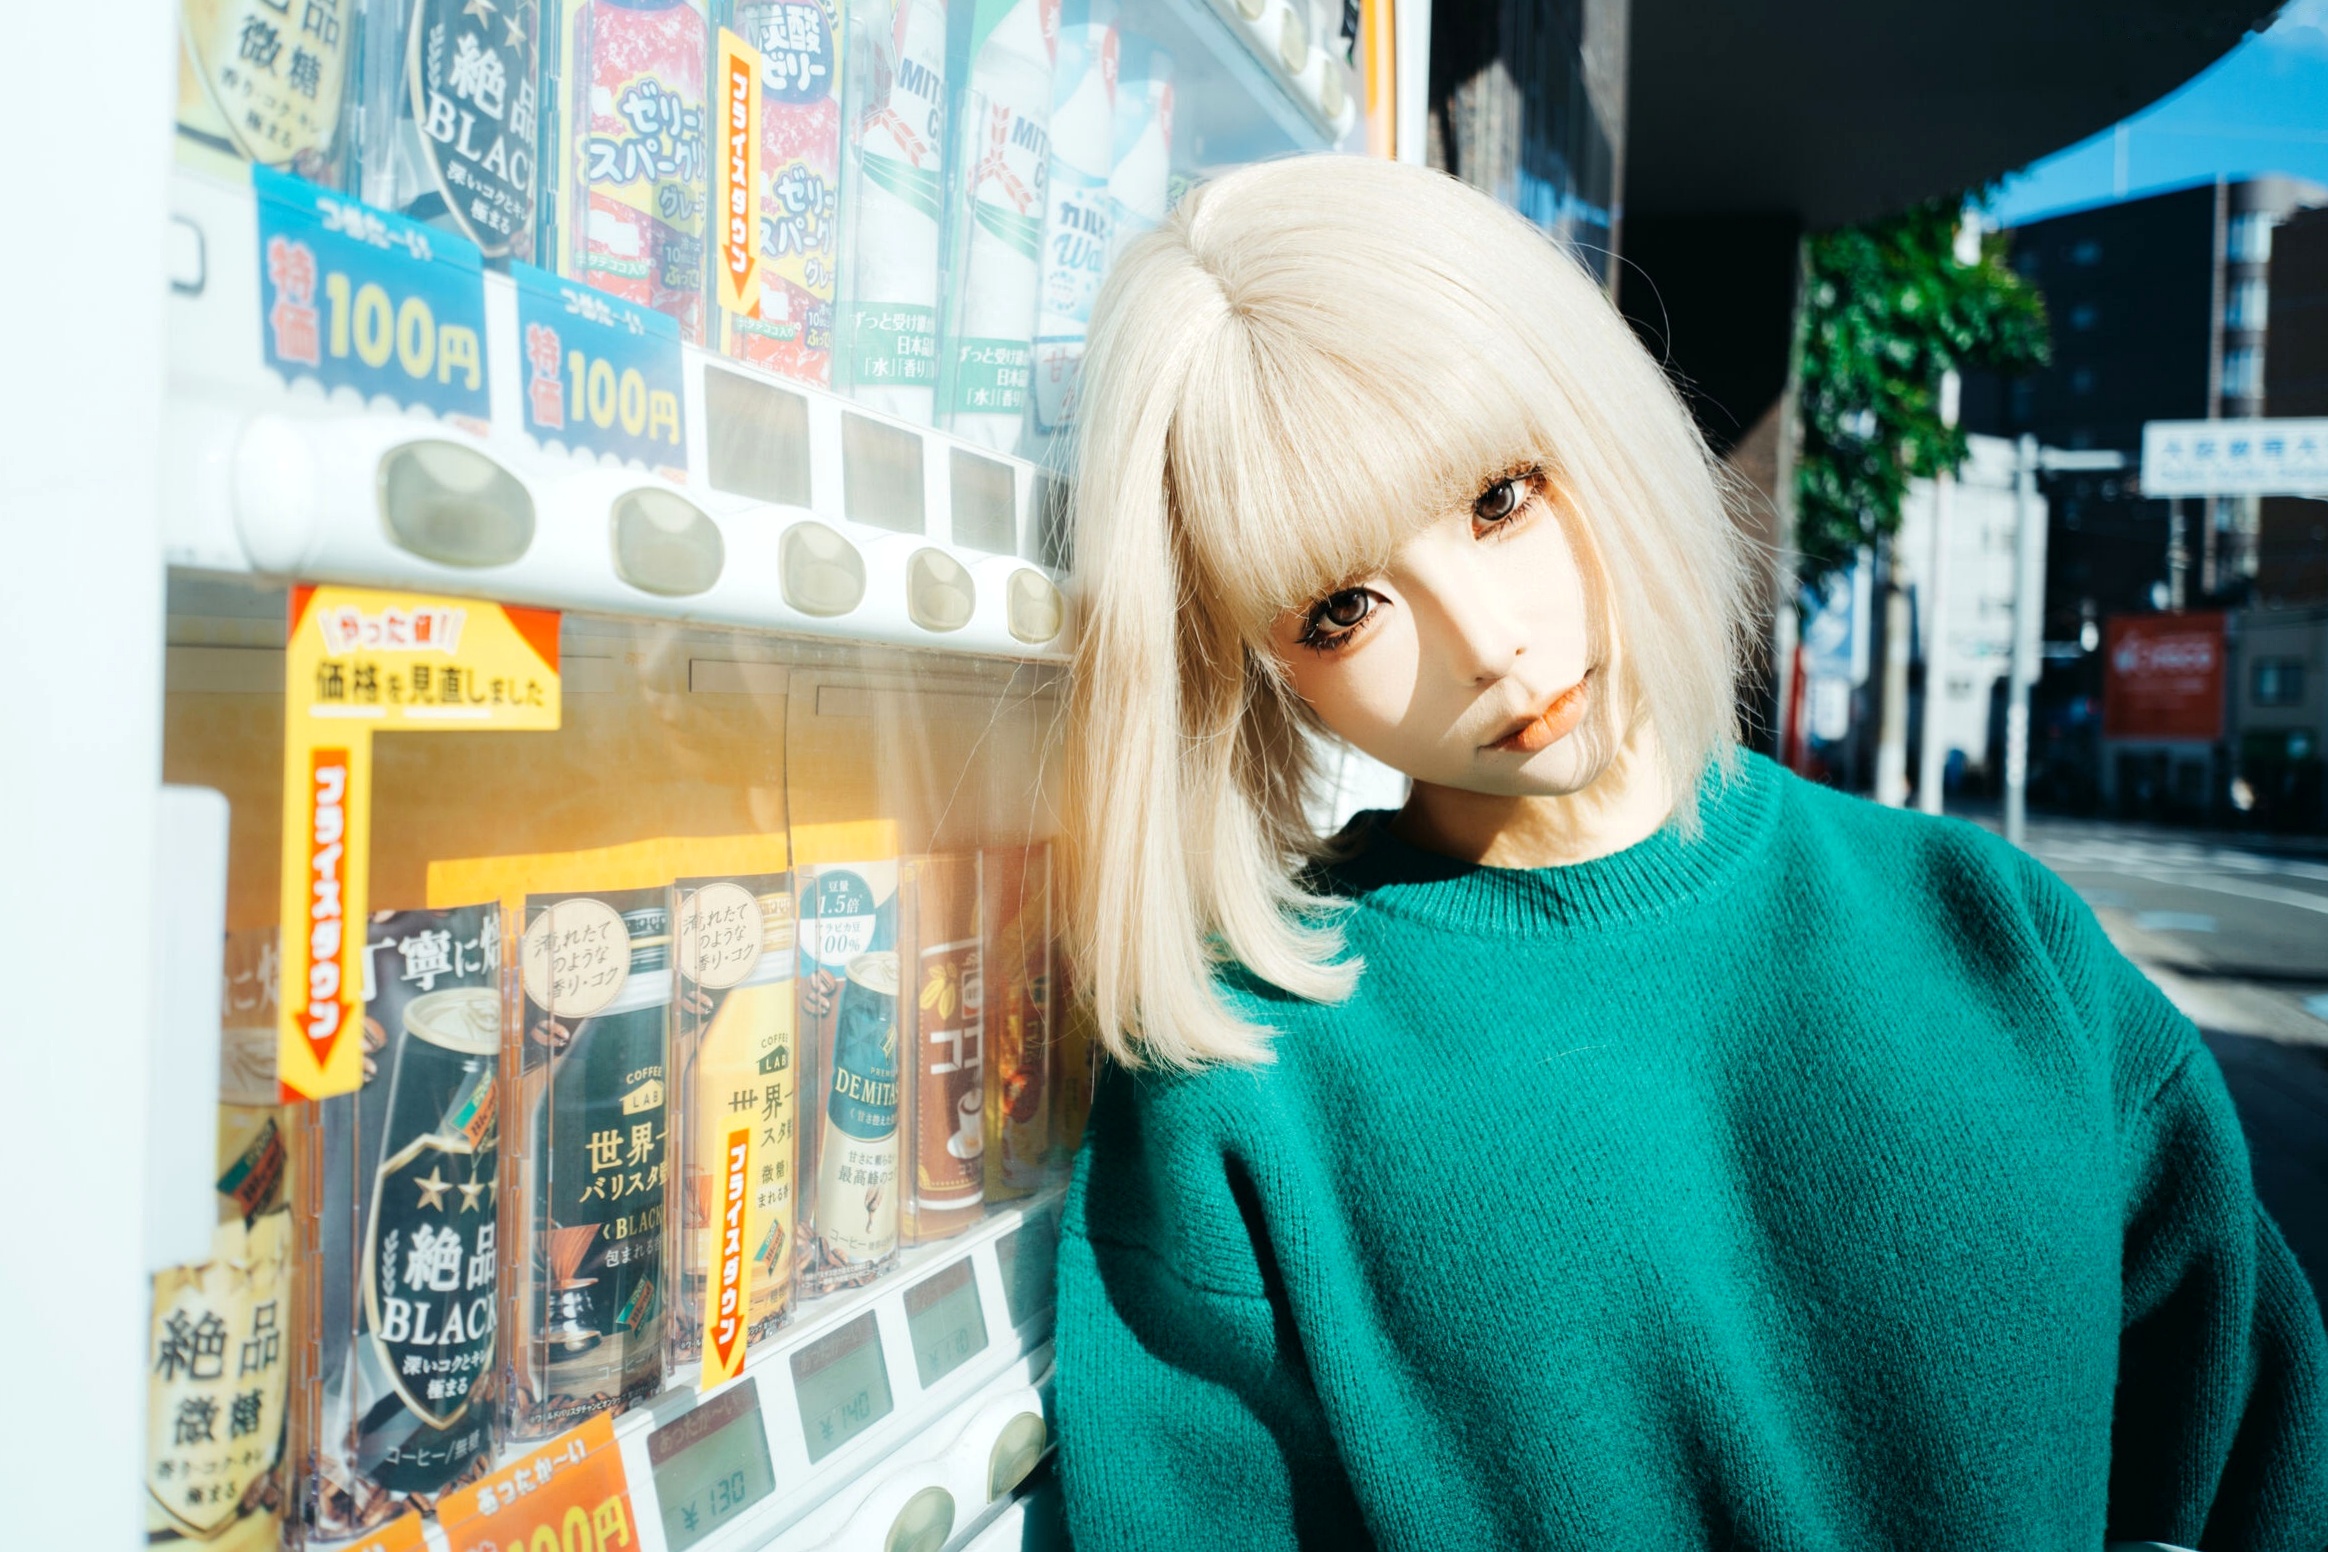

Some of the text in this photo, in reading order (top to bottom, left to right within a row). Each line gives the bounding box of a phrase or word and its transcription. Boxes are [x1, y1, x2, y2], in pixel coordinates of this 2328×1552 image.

[745, 4, 821, 54] 炭酸
[238, 12, 323, 102] 微糖
[761, 51, 826, 91] ゼリー
[450, 32, 535, 147] 絶品
[622, 81, 698, 135] ゼリー
[777, 167, 834, 214] ゼリー
[471, 199, 511, 235] 極まる
[267, 235, 320, 367] 特価
[326, 272, 480, 391] 100円
[527, 322, 563, 429] 特価
[567, 349, 680, 445] 100円
[316, 661, 545, 707] 価格を見直しました
[534, 920, 611, 958] 淹れたて
[683, 903, 748, 935] 淹れたて
[700, 924, 746, 949] のような
[553, 945, 609, 973] のような
[626, 1066, 662, 1085] COFFEE
[766, 1054, 787, 1071] LAB
[633, 1090, 659, 1108] LAB
[585, 1121, 669, 1174] 世界一
[762, 1160, 785, 1184] 微糖
[403, 1222, 497, 1291] 絶品
[718, 1143, 747, 1346] プライスダウン
[830, 1228, 867, 1250] コーヒー
[155, 1299, 280, 1381] 絶品
[427, 1377, 468, 1400] 極まる
[174, 1388, 264, 1446] 微糖
[186, 1481, 237, 1506] 極まる
